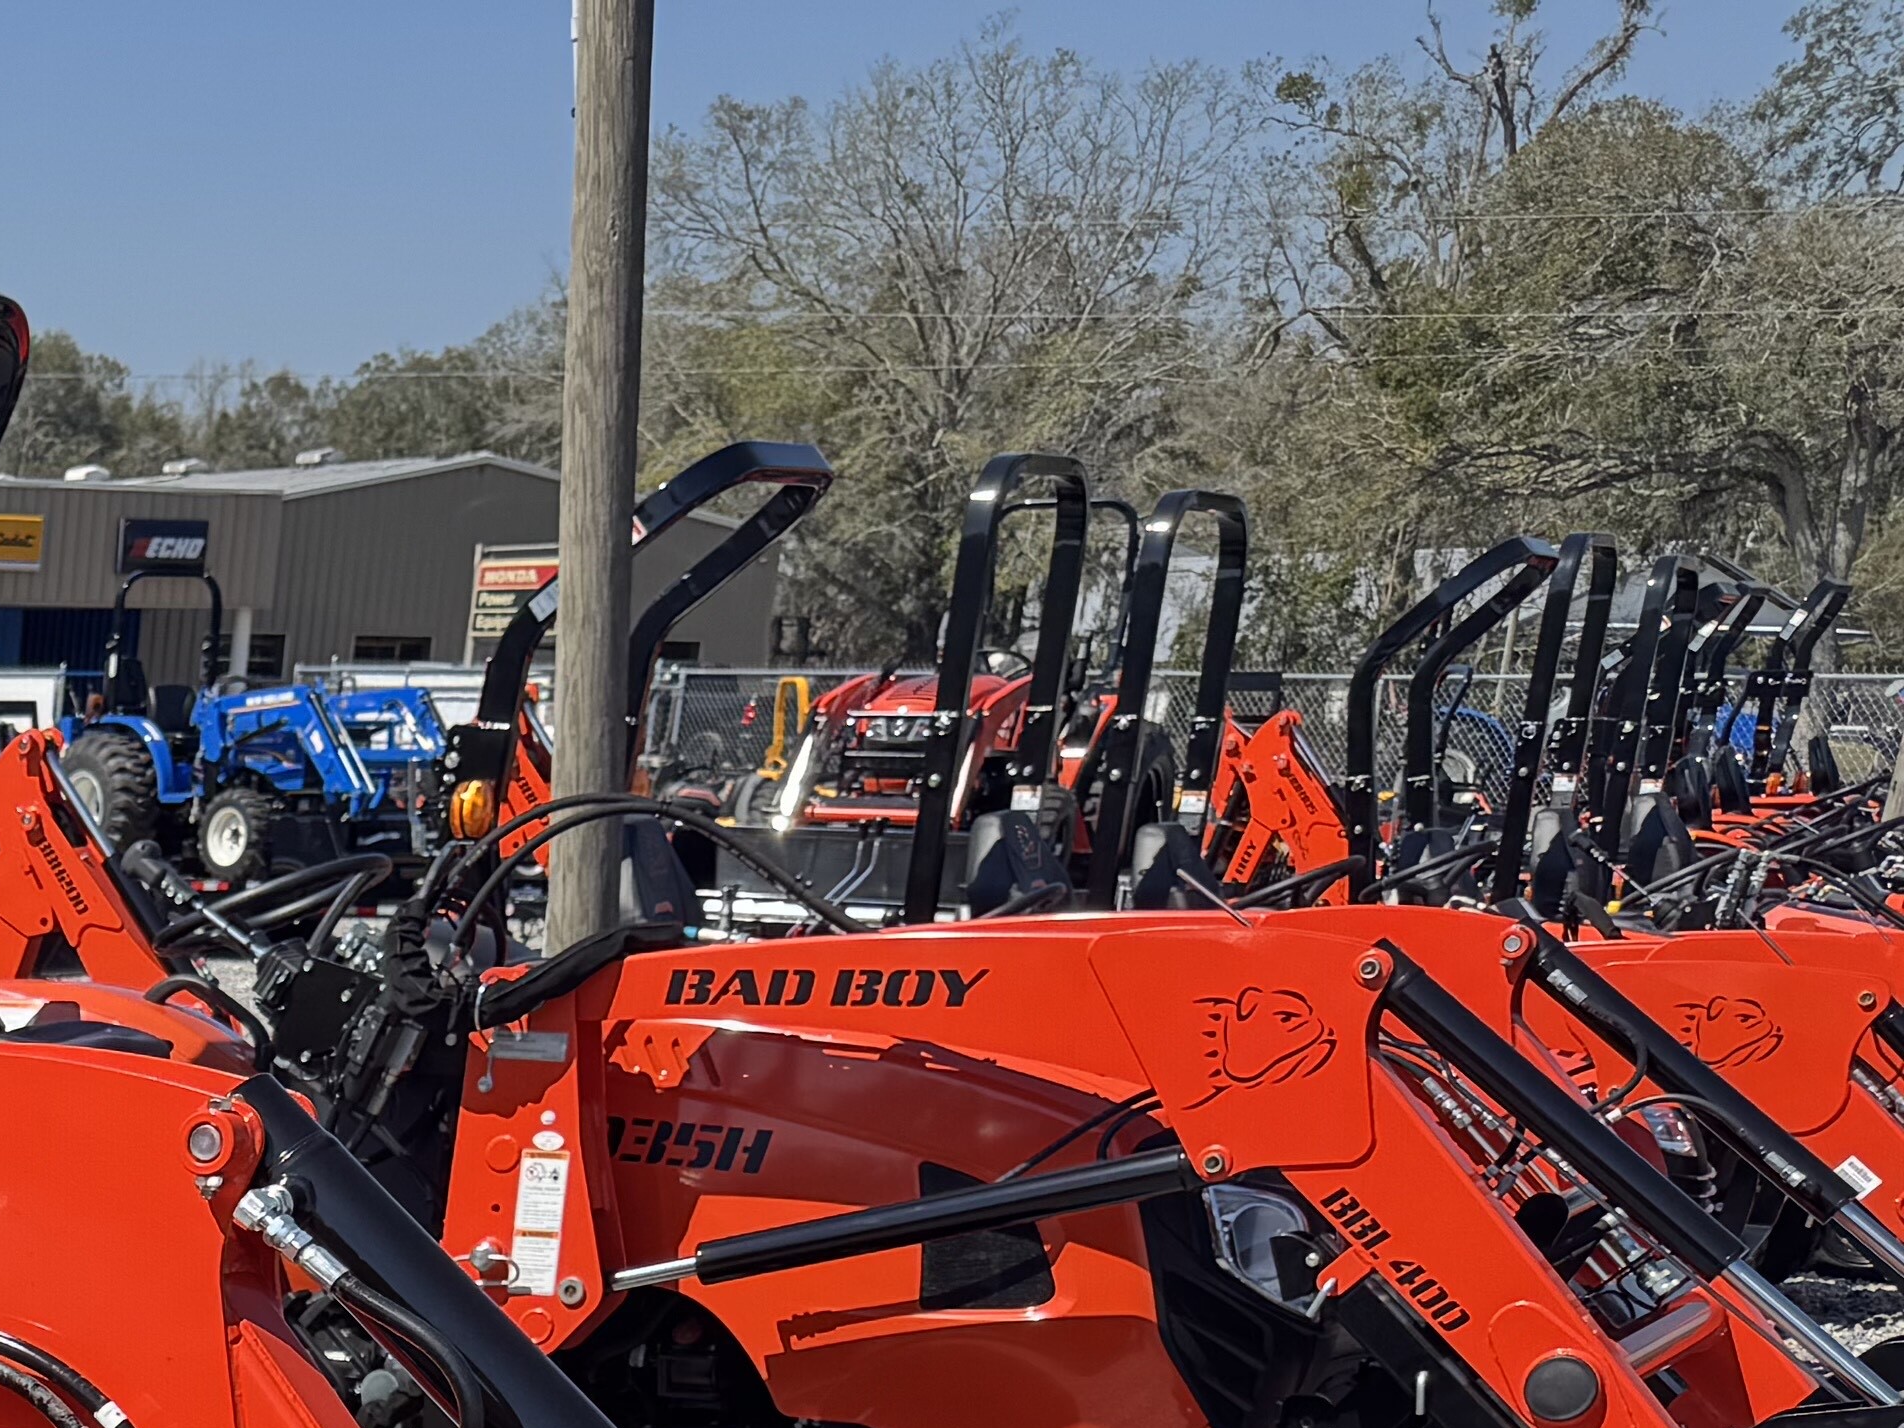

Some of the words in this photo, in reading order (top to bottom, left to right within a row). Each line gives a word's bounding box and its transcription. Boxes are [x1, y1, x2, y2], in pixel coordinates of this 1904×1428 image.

[145, 536, 204, 559] ECHO
[483, 568, 538, 584] HONDA
[665, 969, 816, 1006] BAD
[831, 969, 989, 1007] BOY
[1319, 1187, 1380, 1262] BBL
[1388, 1244, 1470, 1334] 400
